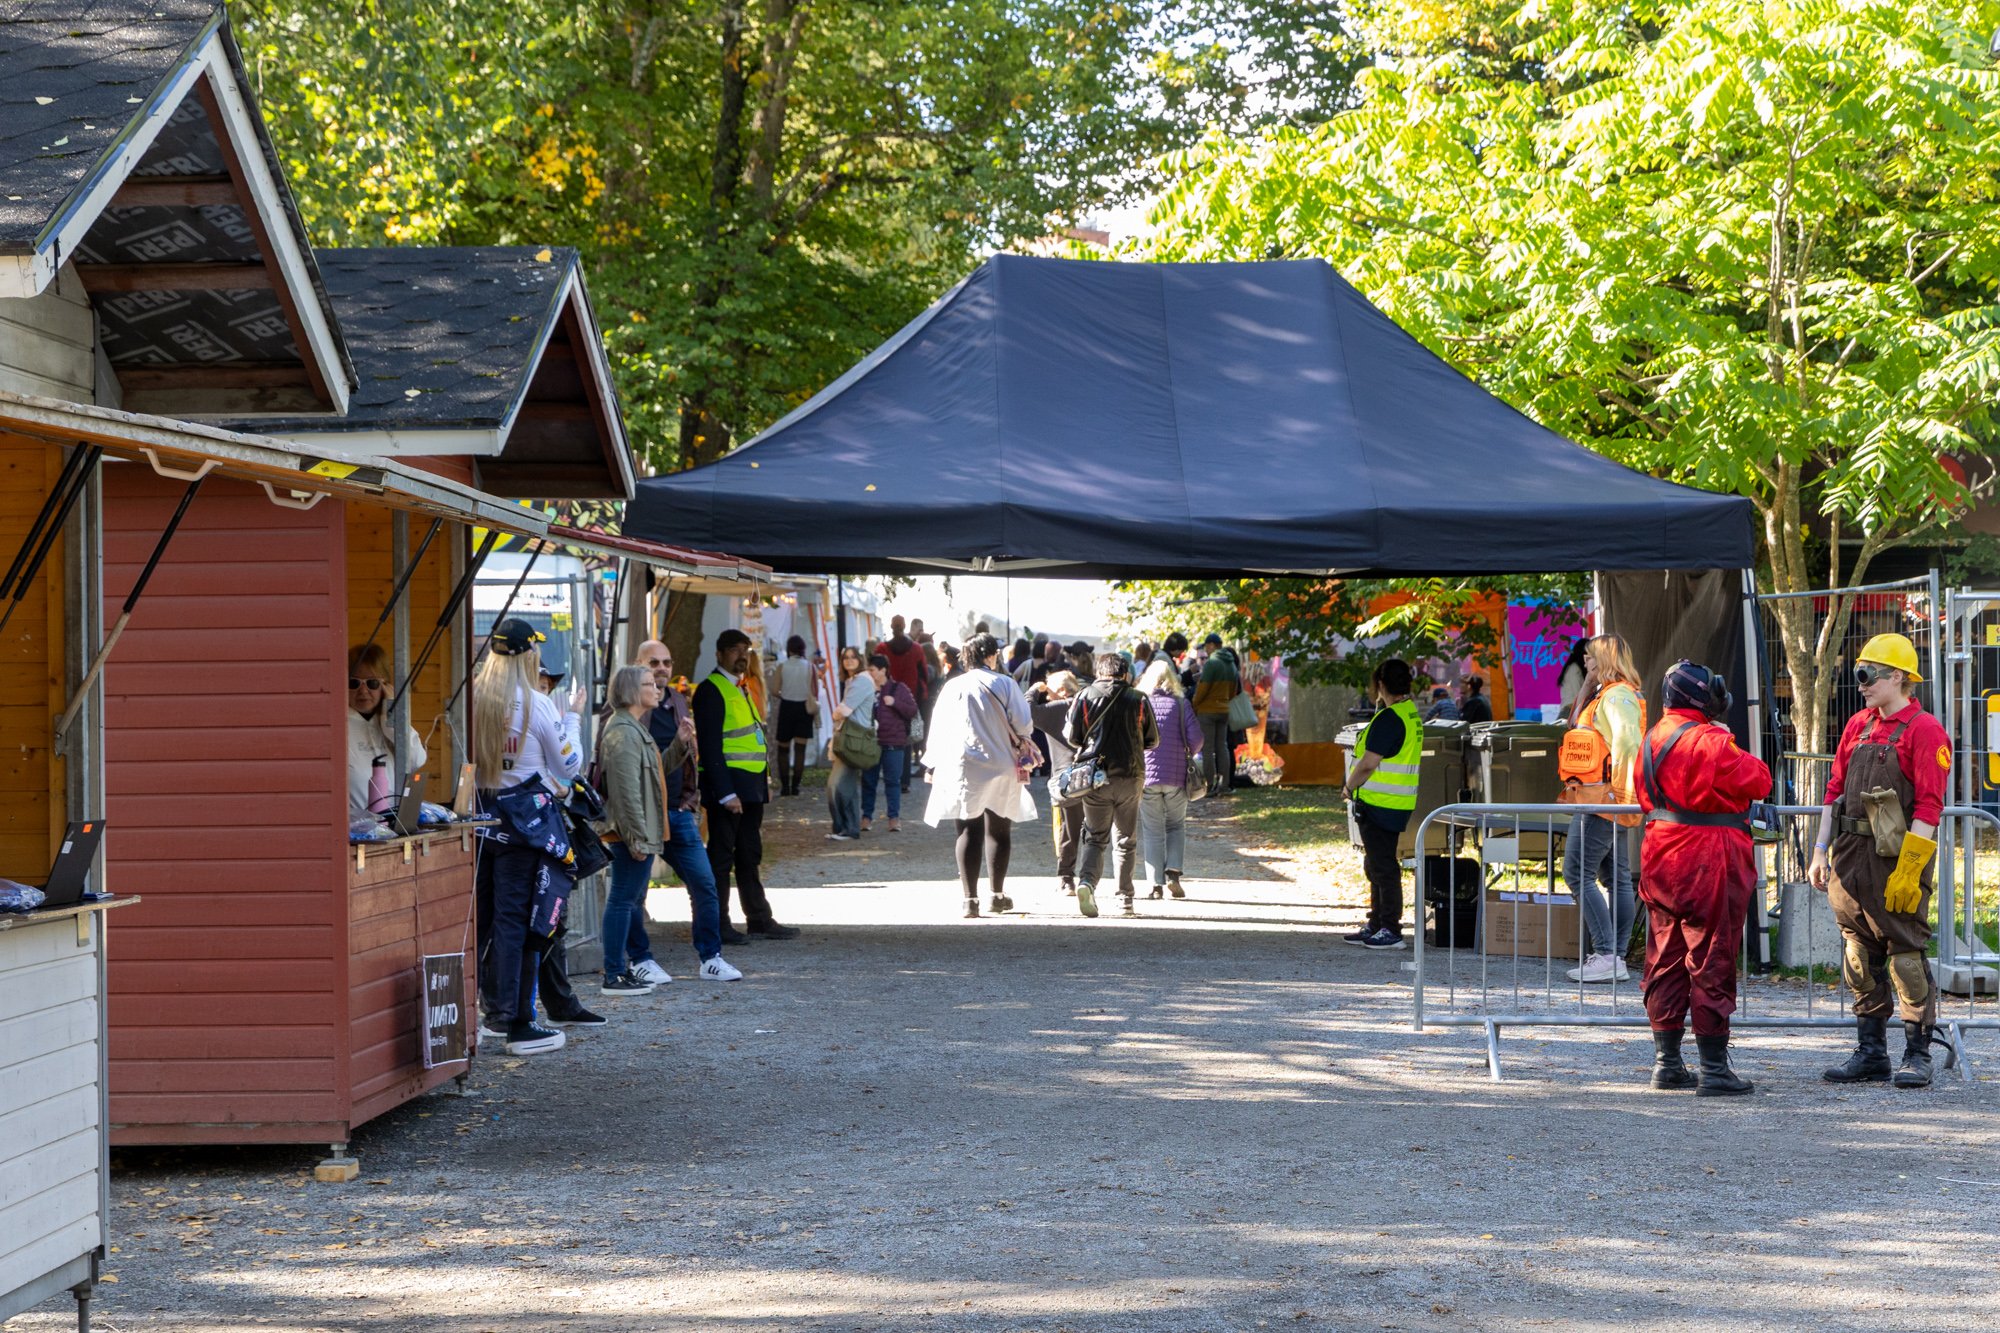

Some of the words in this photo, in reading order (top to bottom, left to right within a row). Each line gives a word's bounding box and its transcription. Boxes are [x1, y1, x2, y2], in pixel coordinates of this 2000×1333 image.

[200, 205, 251, 238] PER
[125, 229, 198, 261] PERI
[161, 323, 225, 361] PERI
[238, 316, 290, 341] ERI
